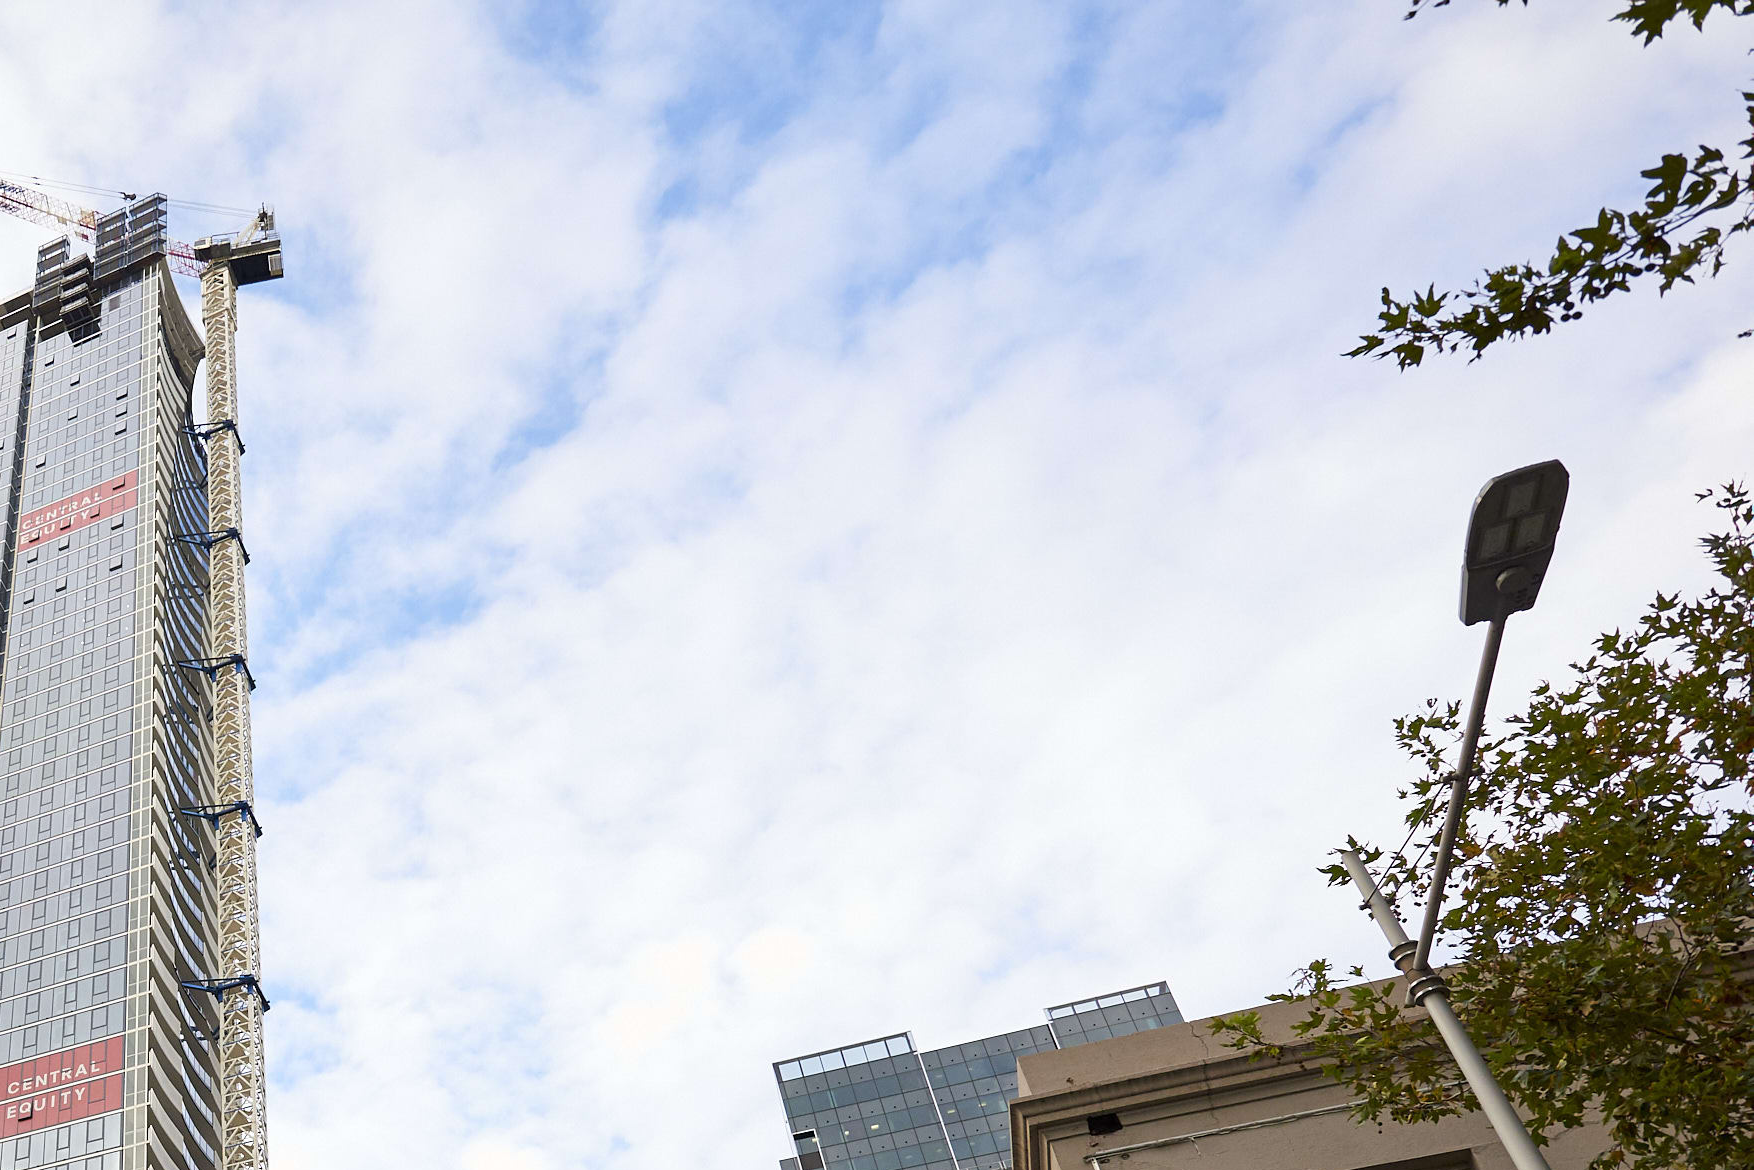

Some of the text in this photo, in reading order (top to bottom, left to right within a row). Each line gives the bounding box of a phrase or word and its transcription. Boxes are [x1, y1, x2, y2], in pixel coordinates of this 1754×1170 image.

[20, 510, 91, 545] EQUITY
[22, 492, 102, 530] CENTRAL
[7, 1060, 100, 1095] CENTRAL
[7, 1087, 86, 1120] EQUITY
